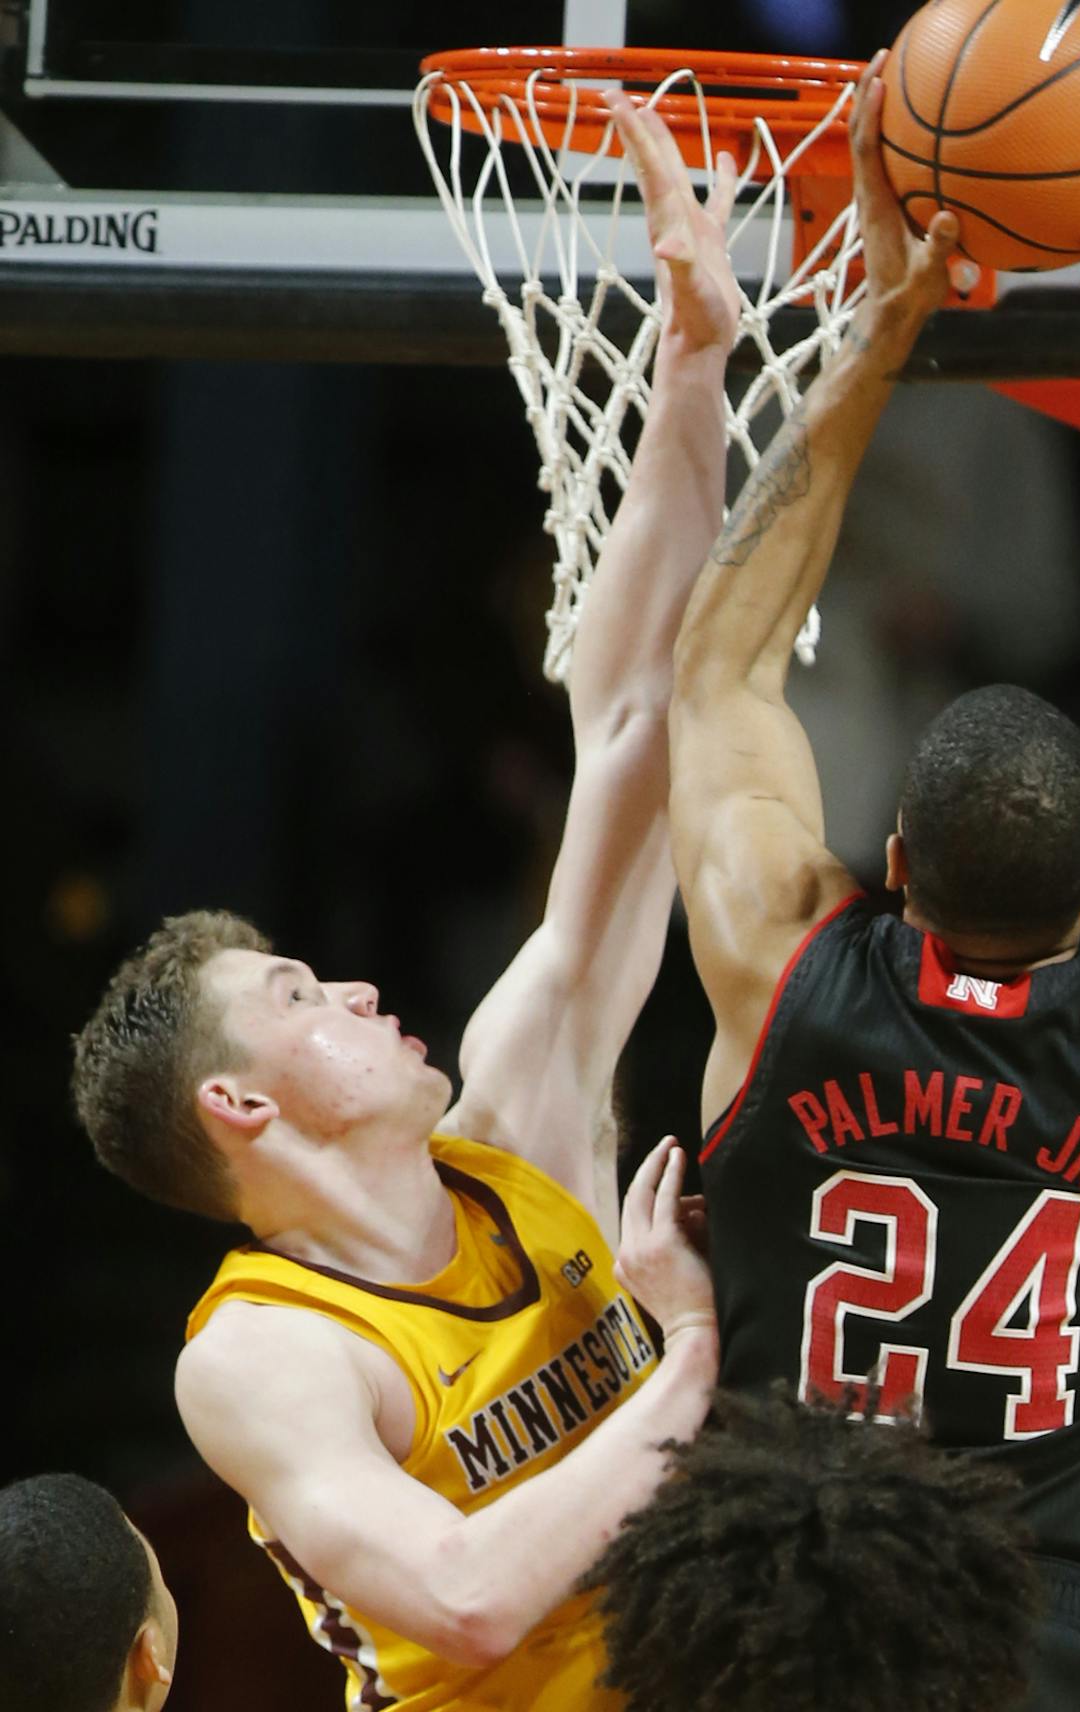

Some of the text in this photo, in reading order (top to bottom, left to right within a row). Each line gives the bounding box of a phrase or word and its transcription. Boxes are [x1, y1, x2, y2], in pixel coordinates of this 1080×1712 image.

[946, 973, 1002, 1010] N
[788, 1070, 1022, 1153] PALMER
[445, 1294, 654, 1494] MINNESOTA
